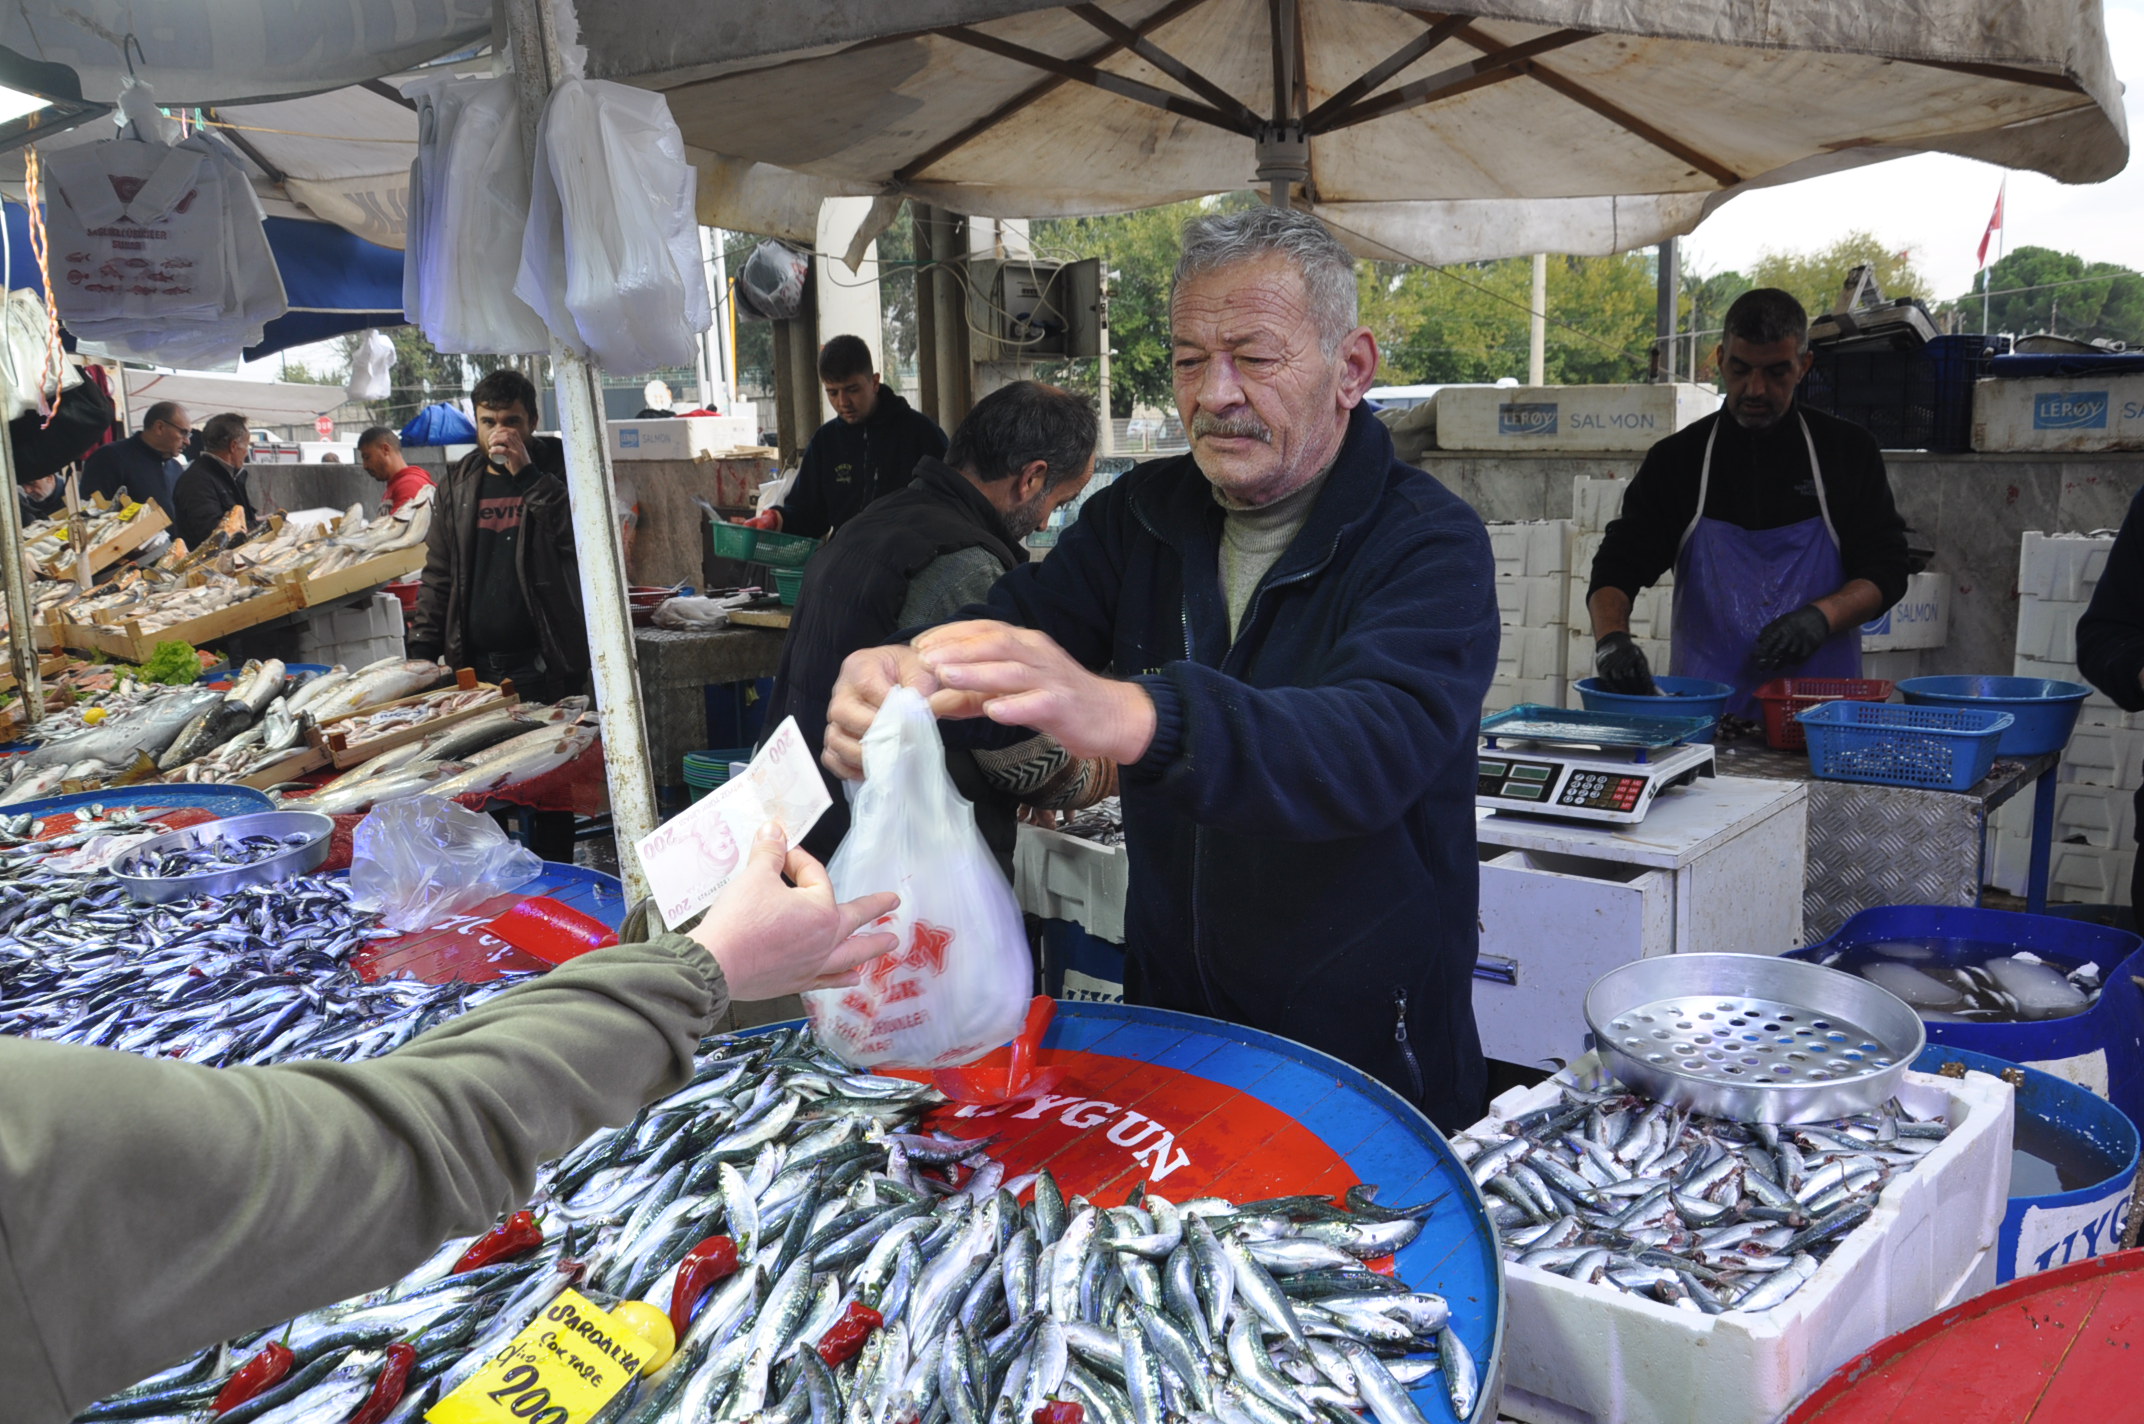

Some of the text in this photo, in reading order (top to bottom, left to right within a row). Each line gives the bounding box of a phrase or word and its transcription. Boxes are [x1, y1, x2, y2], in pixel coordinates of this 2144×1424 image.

[2041, 401, 2099, 417] LERØY
[1571, 413, 1654, 429] SALMON
[1897, 603, 1937, 623] SALMON
[643, 827, 676, 861] 200
[667, 899, 692, 921] 200
